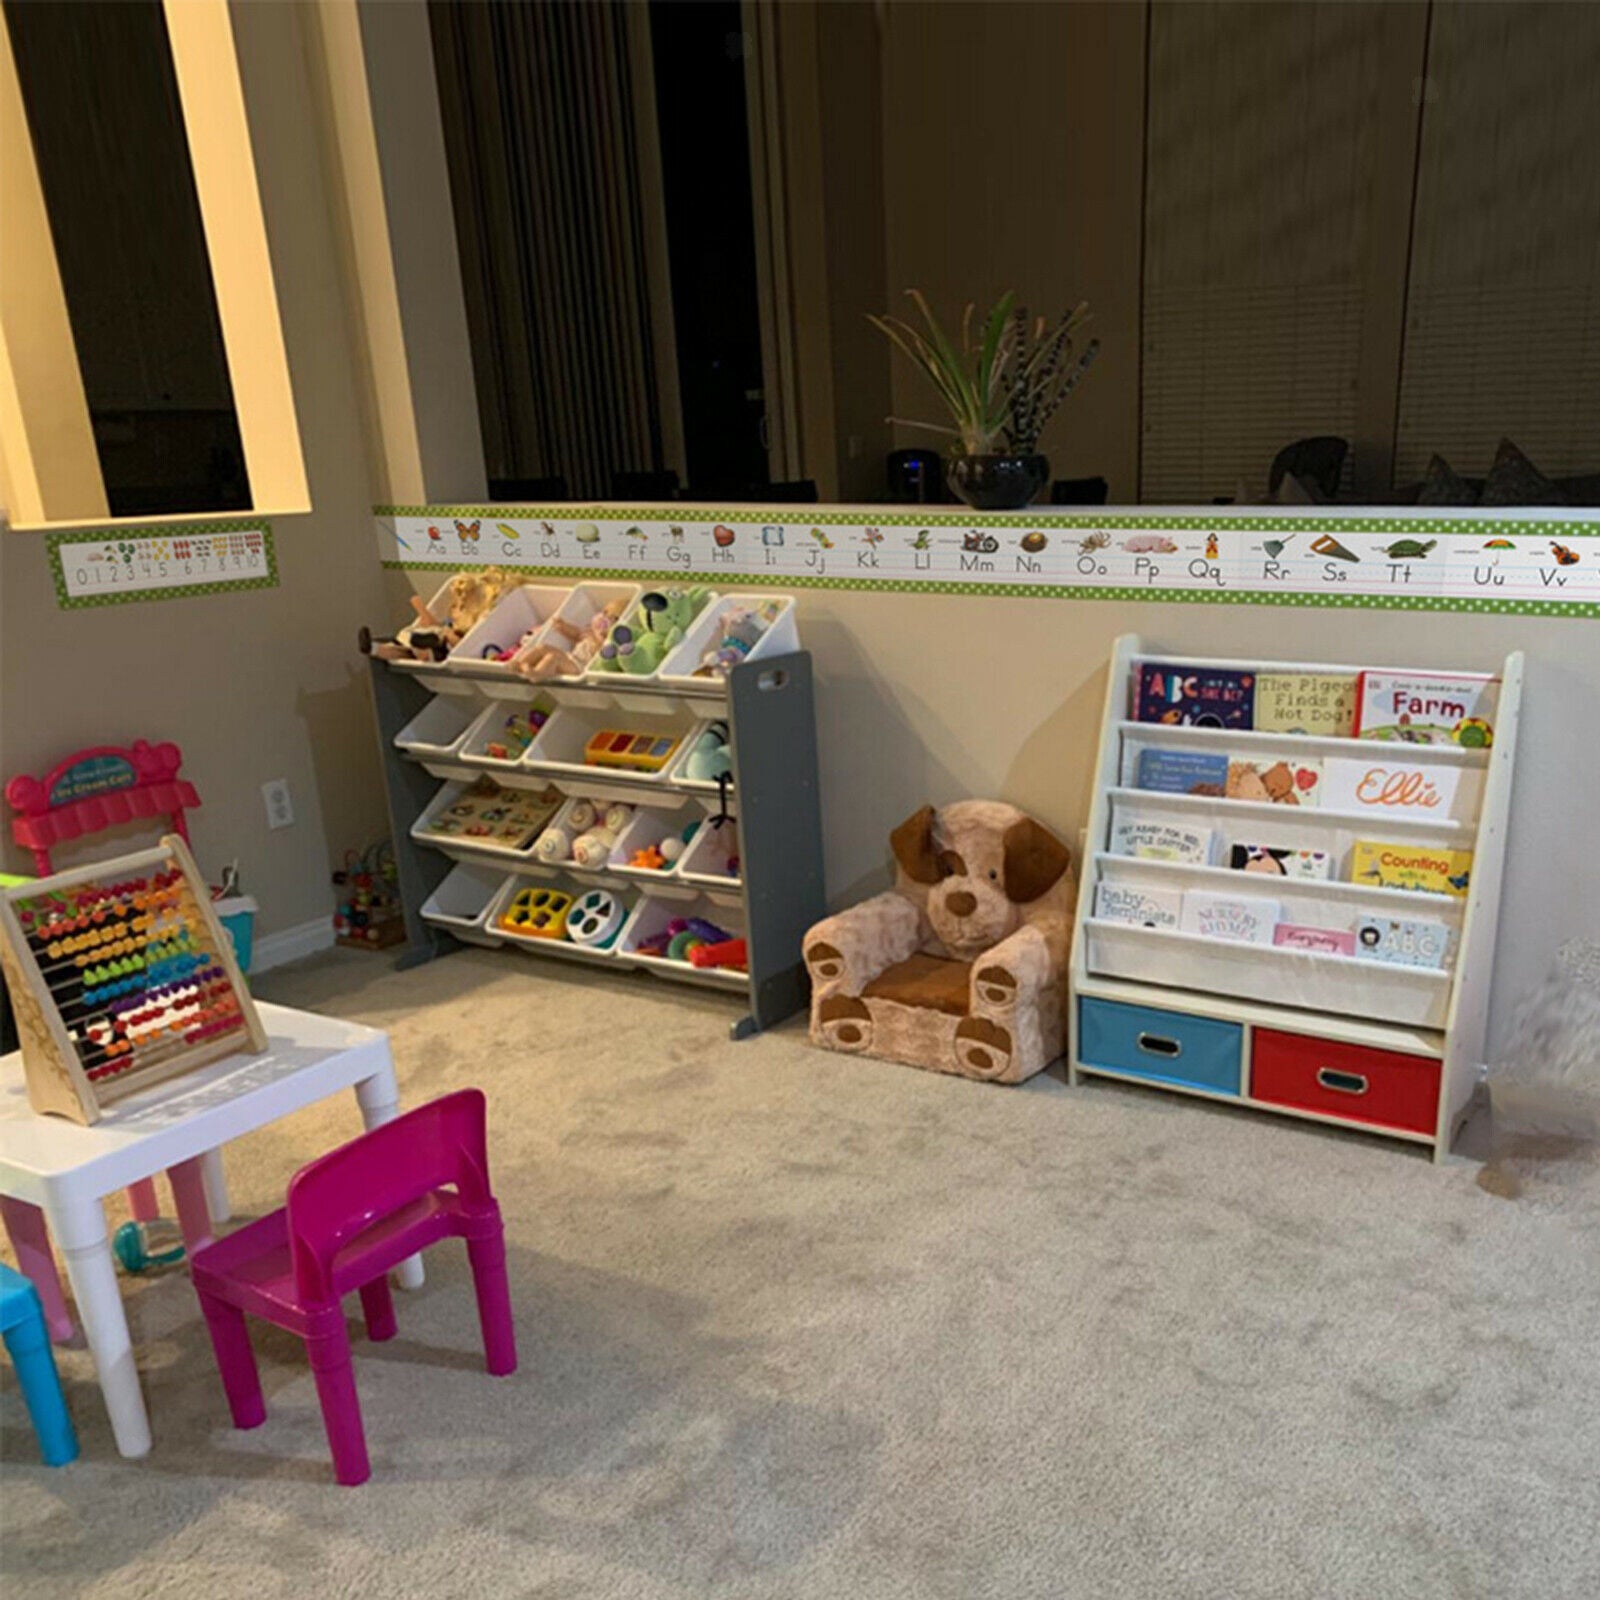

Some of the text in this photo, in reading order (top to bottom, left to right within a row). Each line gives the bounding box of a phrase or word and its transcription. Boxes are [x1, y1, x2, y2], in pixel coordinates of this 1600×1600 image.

[76, 568, 88, 586] 0
[109, 566, 118, 583] 2
[126, 564, 136, 581] 3
[141, 562, 152, 577] 4
[158, 561, 168, 578] 5
[184, 561, 193, 576] 6
[200, 558, 208, 573] 7
[218, 557, 227, 572] 8
[233, 555, 242, 570] 9
[246, 553, 260, 568] 10
[461, 541, 479, 556] Bb
[502, 541, 522, 557] Cc
[540, 542, 560, 558] Dd
[582, 543, 601, 559] Ee
[628, 544, 648, 561] Ff
[666, 545, 692, 569] Gg
[712, 547, 736, 563] Hh
[764, 548, 777, 565] Ii
[805, 549, 826, 574] Jj
[856, 551, 880, 568] Kk
[915, 552, 931, 570] Ll
[960, 554, 995, 572] Mm
[1016, 556, 1042, 573] Nn
[1077, 556, 1108, 575] Oo
[1134, 557, 1160, 585] Pp
[1188, 558, 1227, 587] Qq
[1263, 560, 1291, 580] Rr
[1322, 562, 1348, 582] Ss
[1386, 563, 1412, 583] Tt
[1473, 566, 1505, 586] Uu
[1539, 567, 1568, 587] Vv
[1149, 671, 1199, 704] ABC
[1258, 677, 1292, 692] The
[1275, 692, 1345, 708] Finds a
[1393, 691, 1466, 719] Farm
[1311, 708, 1353, 723] Dog!
[1355, 768, 1443, 808] Ellie
[1380, 851, 1450, 876] Counting
[1102, 886, 1146, 909] baby
[1384, 932, 1437, 957] ABC
